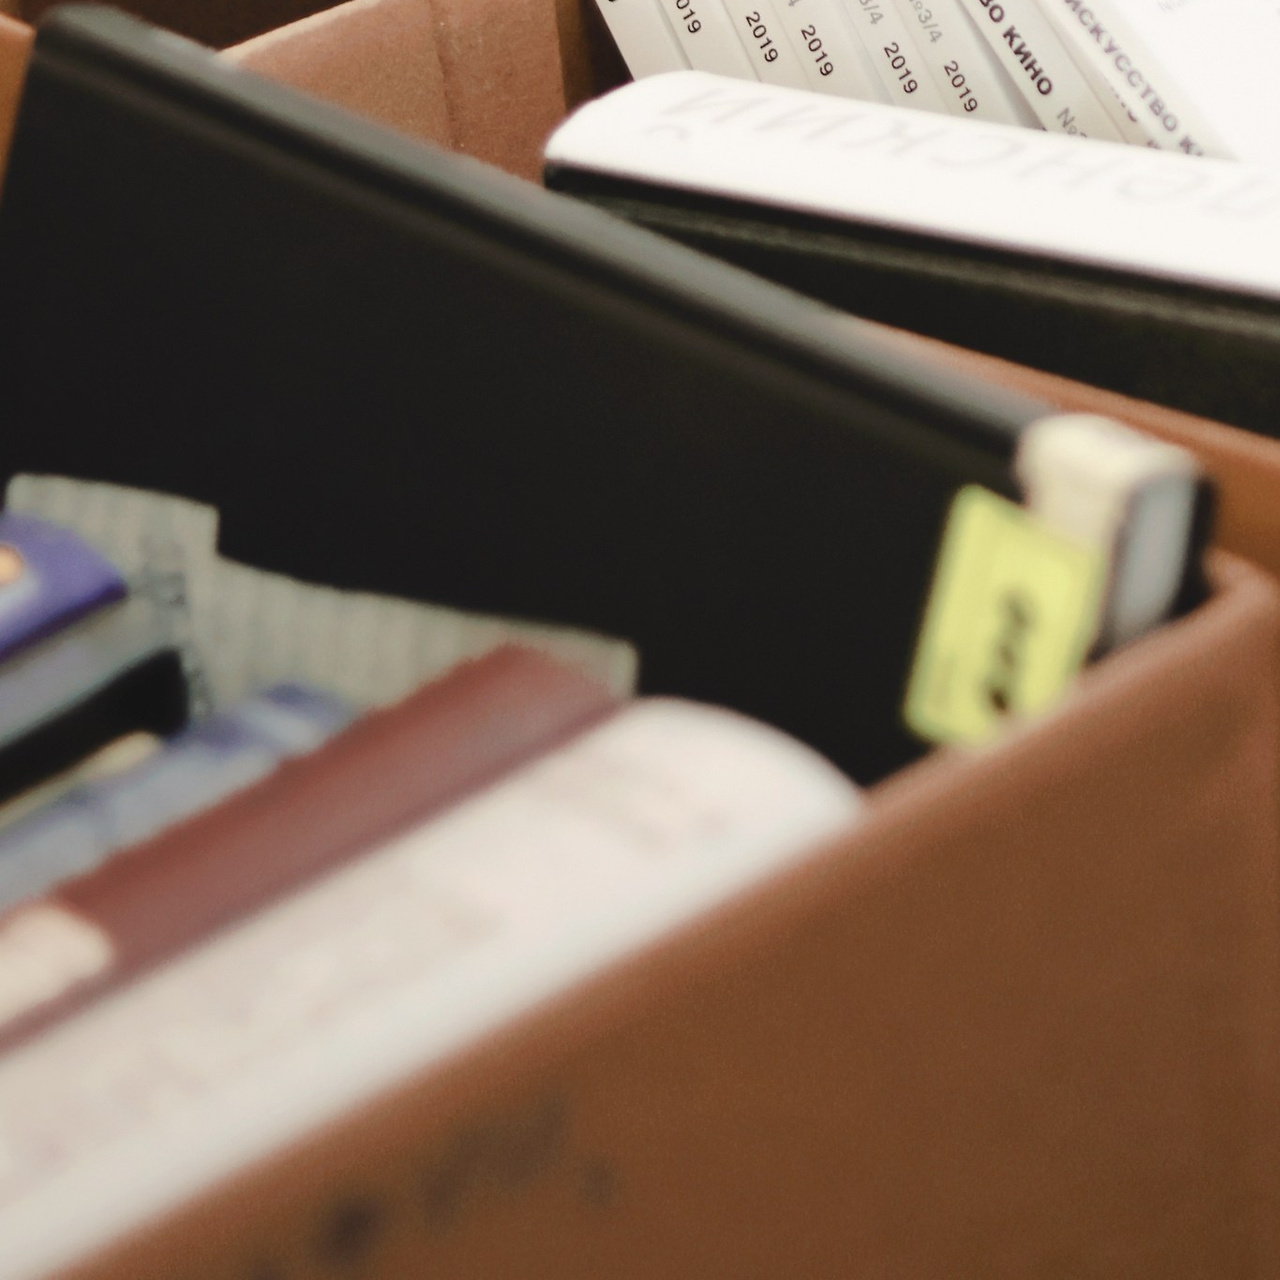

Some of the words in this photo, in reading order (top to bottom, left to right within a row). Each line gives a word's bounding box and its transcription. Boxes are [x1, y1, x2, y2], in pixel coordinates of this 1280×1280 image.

[746, 12, 778, 62] 2019
[801, 25, 833, 76] 2019
[1003, 26, 1052, 95] КИНО
[884, 42, 917, 94] 2019
[944, 61, 977, 112] 2019
